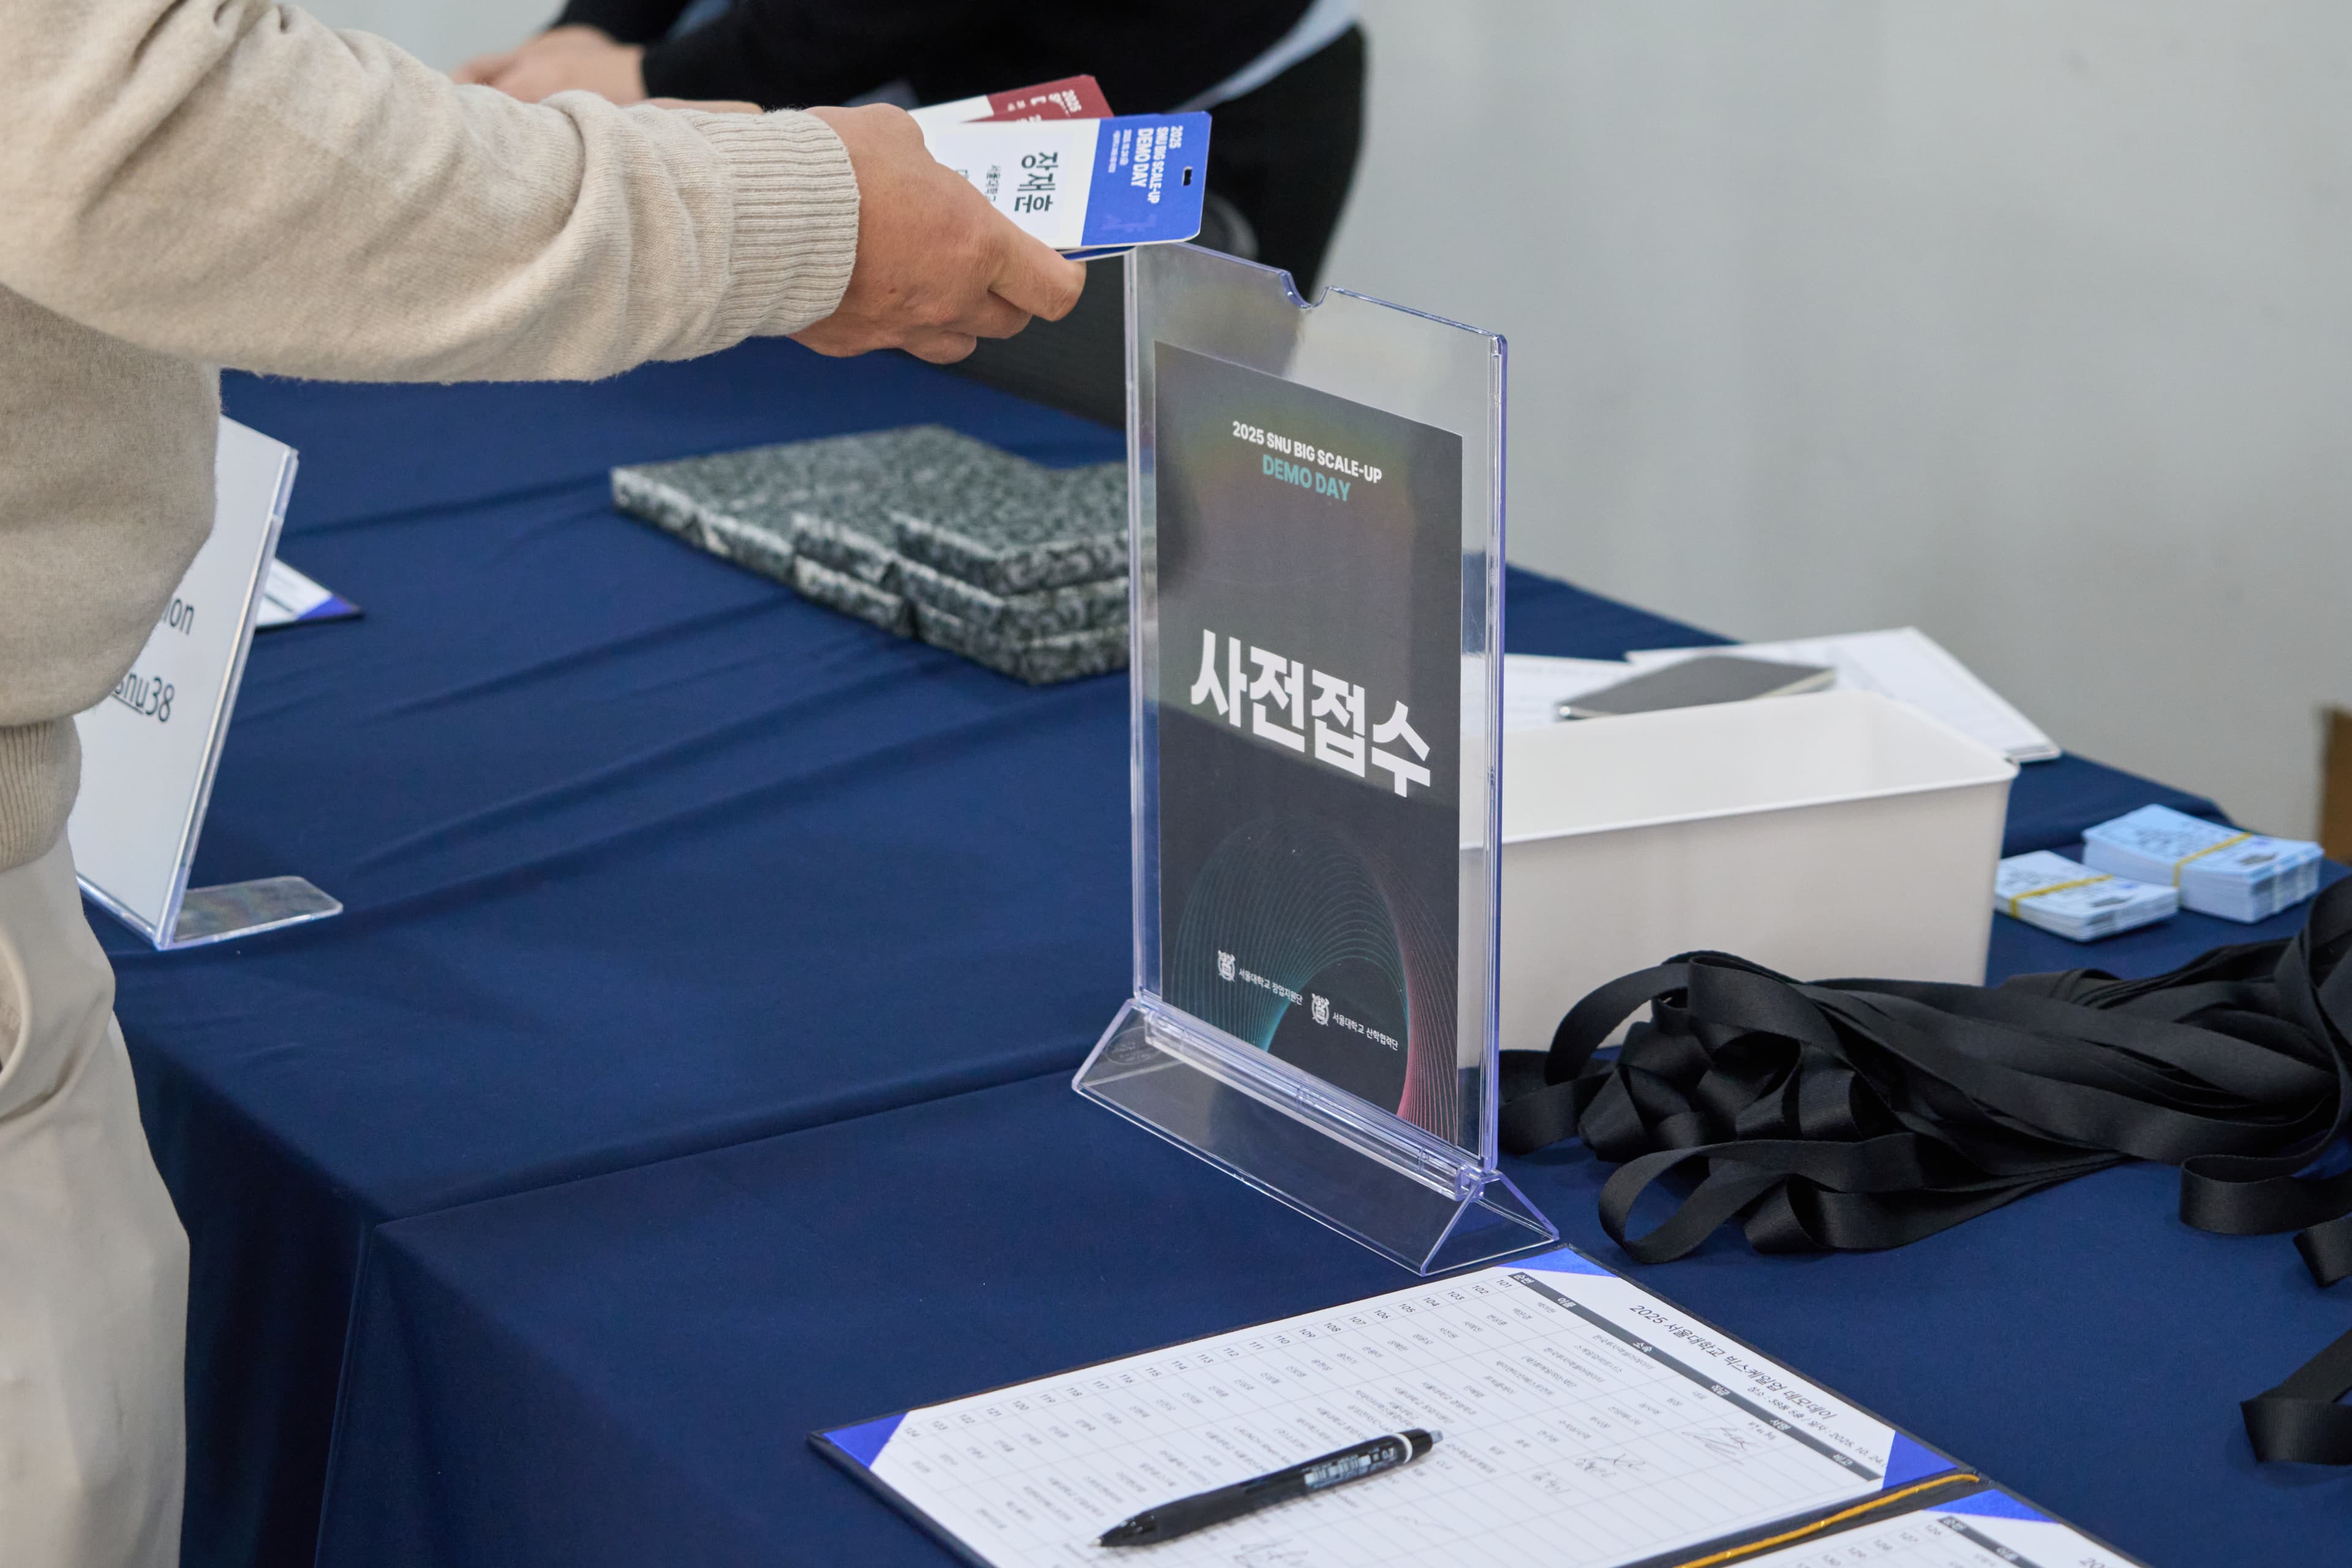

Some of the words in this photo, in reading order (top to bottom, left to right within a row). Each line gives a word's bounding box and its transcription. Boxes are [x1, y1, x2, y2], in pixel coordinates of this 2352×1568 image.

[1169, 125, 1183, 148] 2025
[1134, 127, 1154, 162] DEMO
[1153, 145, 1167, 160] BIG
[1131, 163, 1150, 187] DAY
[1014, 152, 1059, 213] 장재훈
[1148, 160, 1164, 203] SCALE-UP
[1232, 421, 1265, 445] 2025
[1267, 432, 1292, 454] SNU
[1294, 440, 1315, 462] BIG
[1317, 449, 1382, 484] SCALE-UP
[1263, 454, 1312, 489] DEMO
[1316, 472, 1351, 501] DAY
[1191, 628, 1431, 798] 사전접수
[1238, 968, 1271, 990] 서울대학교
[1272, 982, 1303, 1006] 창업지원단
[1332, 1012, 1365, 1035] 서울대학교
[1366, 1028, 1399, 1051] 산학협력단
[1494, 1279, 1513, 1287] 101
[1511, 1273, 1536, 1284] 순번
[1469, 1285, 1490, 1294] 102
[1445, 1291, 1466, 1300] 103
[1421, 1297, 1442, 1306] 104
[1553, 1297, 1577, 1308] 이름
[1396, 1303, 1417, 1313] 105
[1371, 1310, 1392, 1319] 106
[1347, 1316, 1368, 1325] 107
[1322, 1322, 1343, 1332] 108
[1297, 1328, 1317, 1338] 109
[1272, 1335, 1292, 1344] 110
[1246, 1341, 1265, 1350] 111
[1630, 1341, 1656, 1352] 소속
[1220, 1347, 1241, 1357] 112
[1194, 1354, 1215, 1363] 113
[1627, 1305, 1670, 1324] 2025
[1659, 1322, 1730, 1357] 서울대학교
[1717, 1355, 1790, 1392] 빅스케일업
[1777, 1390, 1839, 1420] 데모데이
[1169, 1360, 1189, 1370] 114
[1142, 1366, 1163, 1376] 115
[1116, 1373, 1137, 1383] 116
[1090, 1379, 1111, 1390] 117
